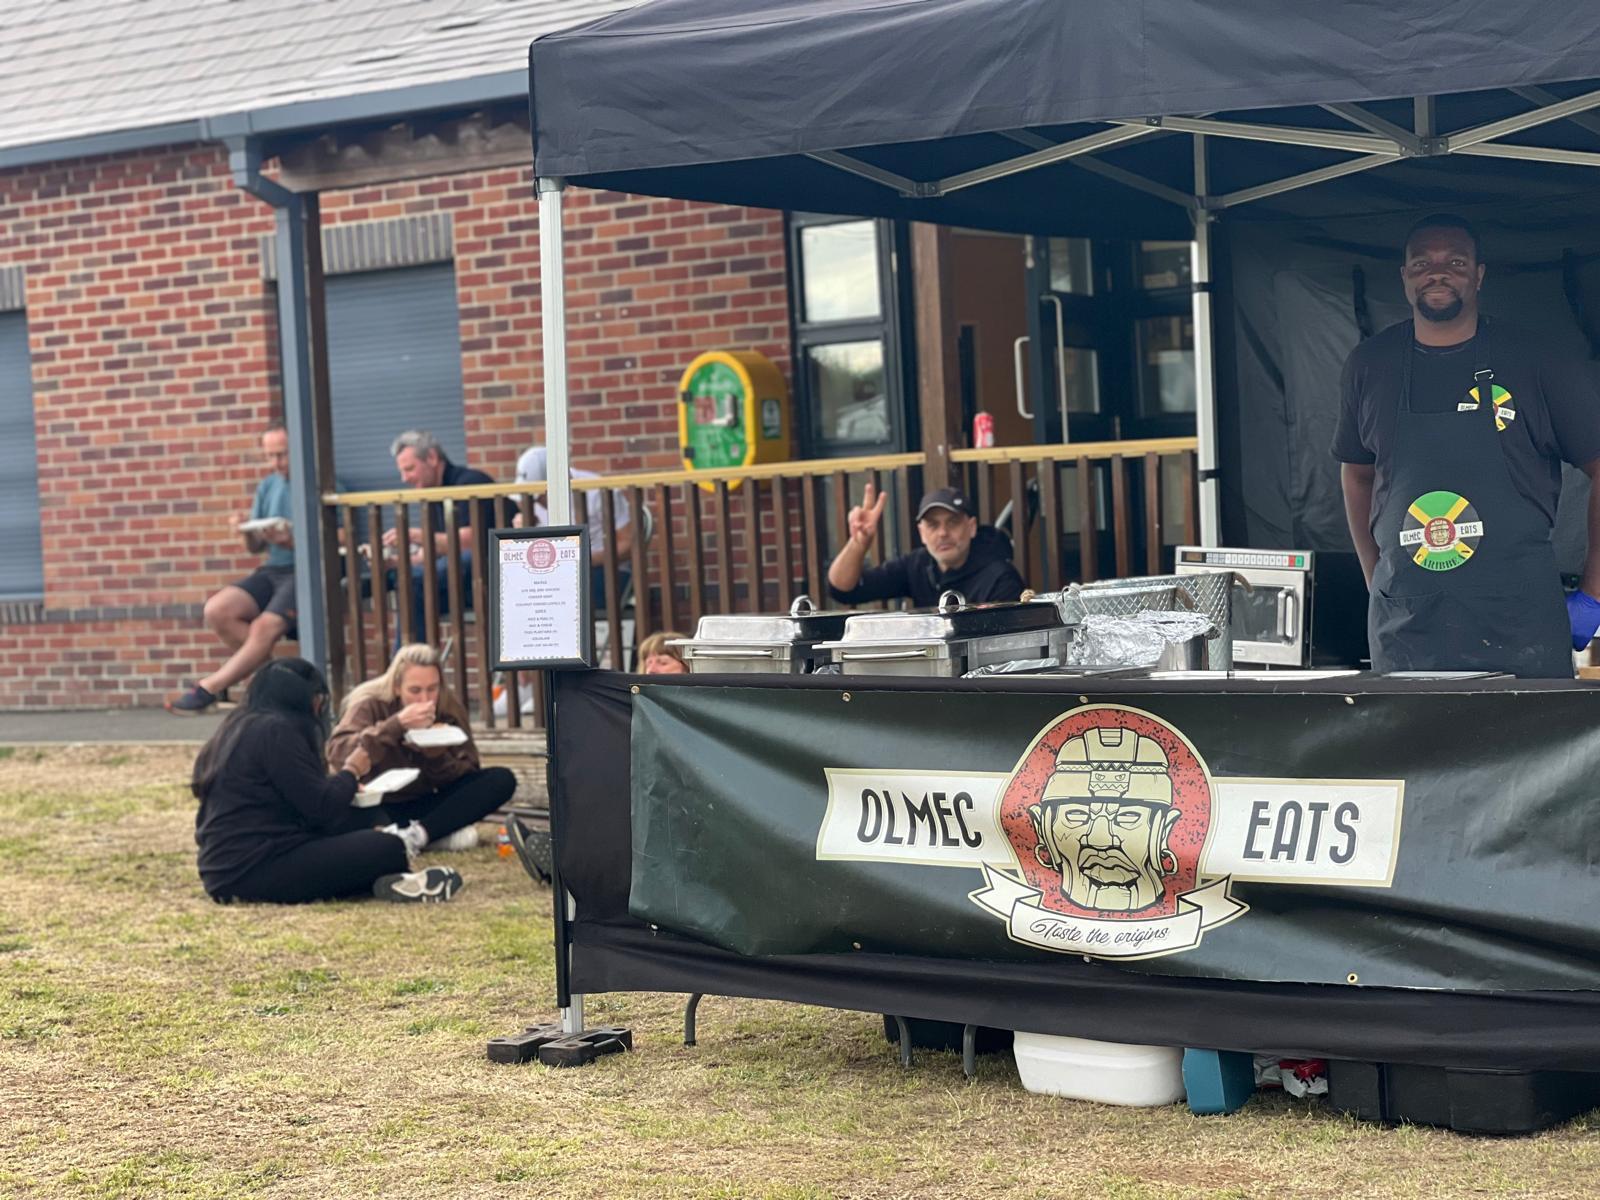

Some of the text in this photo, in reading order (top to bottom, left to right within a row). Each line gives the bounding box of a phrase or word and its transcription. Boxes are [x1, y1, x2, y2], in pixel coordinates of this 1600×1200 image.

[1402, 524, 1478, 543] OLMEC EATS
[504, 550, 576, 561] OLMEC EATS
[856, 788, 1360, 864] OLMEC EATS
[1030, 918, 1169, 948] Taste the origins
